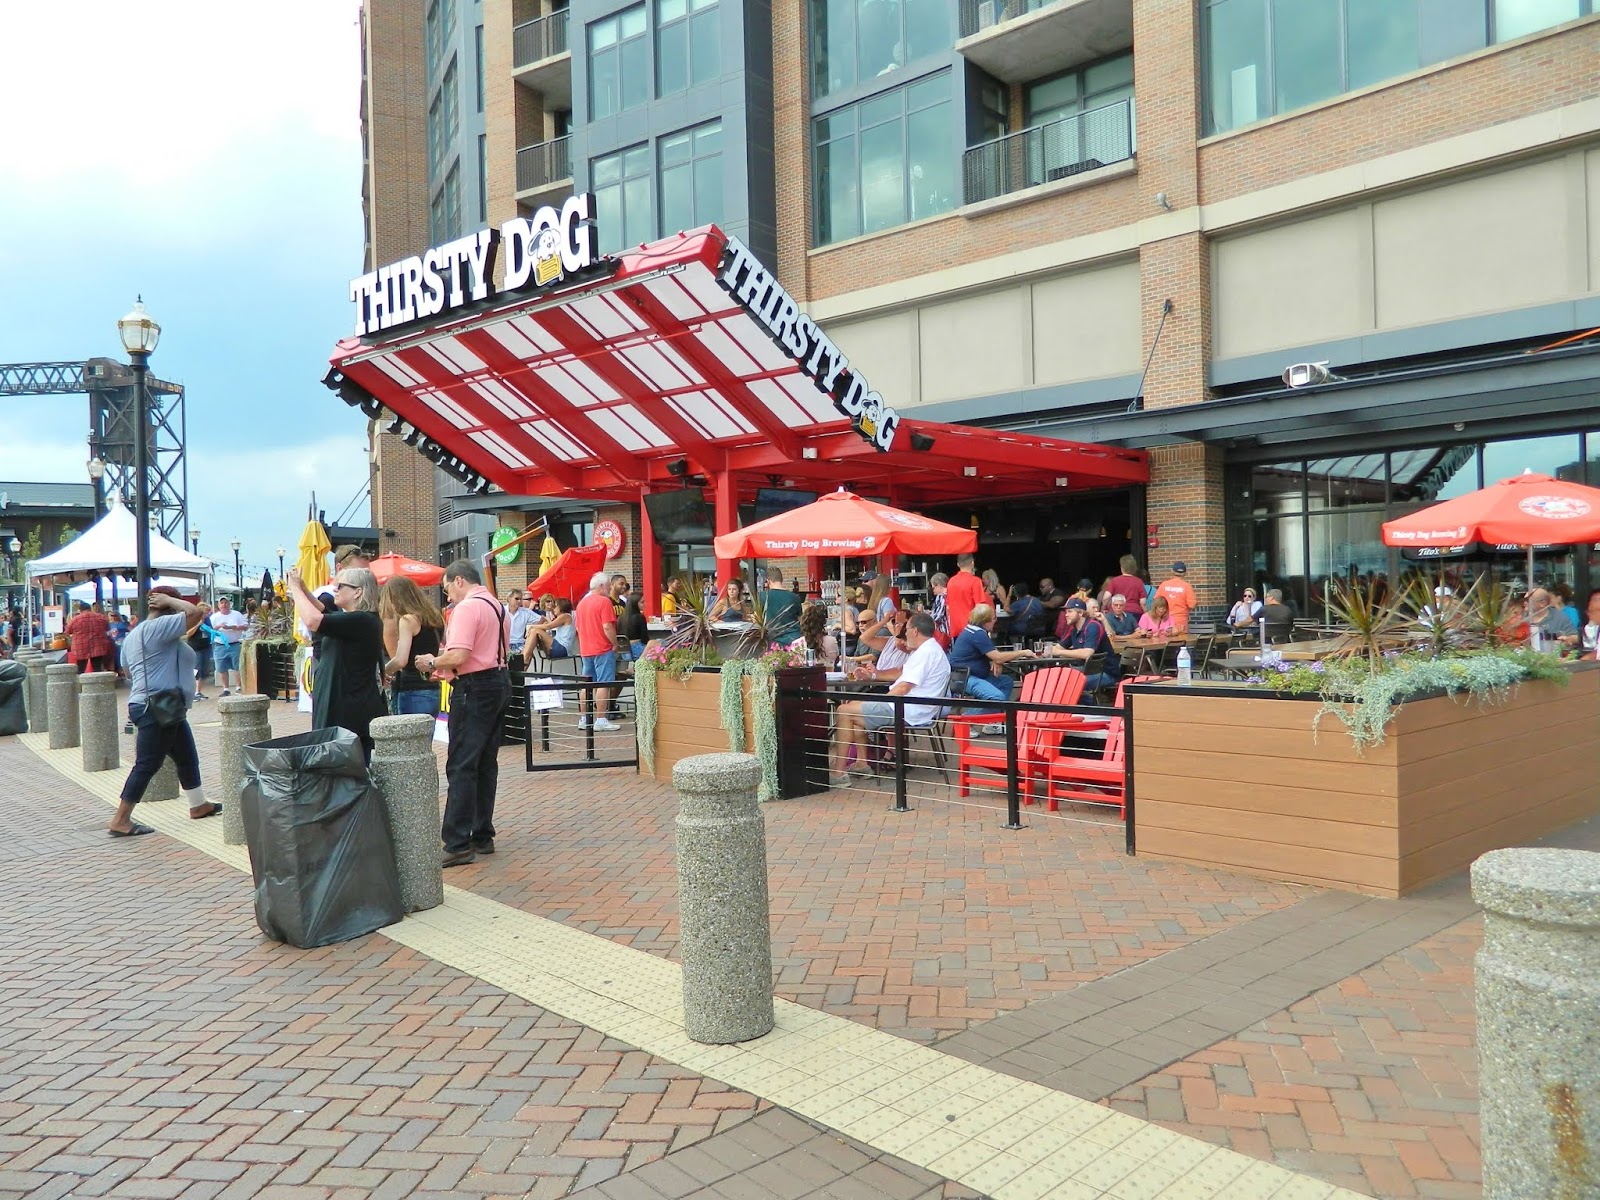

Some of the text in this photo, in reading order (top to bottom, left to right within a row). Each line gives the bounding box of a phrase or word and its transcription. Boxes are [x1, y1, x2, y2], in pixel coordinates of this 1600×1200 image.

[350, 193, 593, 336] THIRSTY DOG
[723, 235, 901, 452] THIRSTY DOG
[765, 539, 861, 550] Thirsty Dog Brewing
[1418, 547, 1440, 556] Tito's
